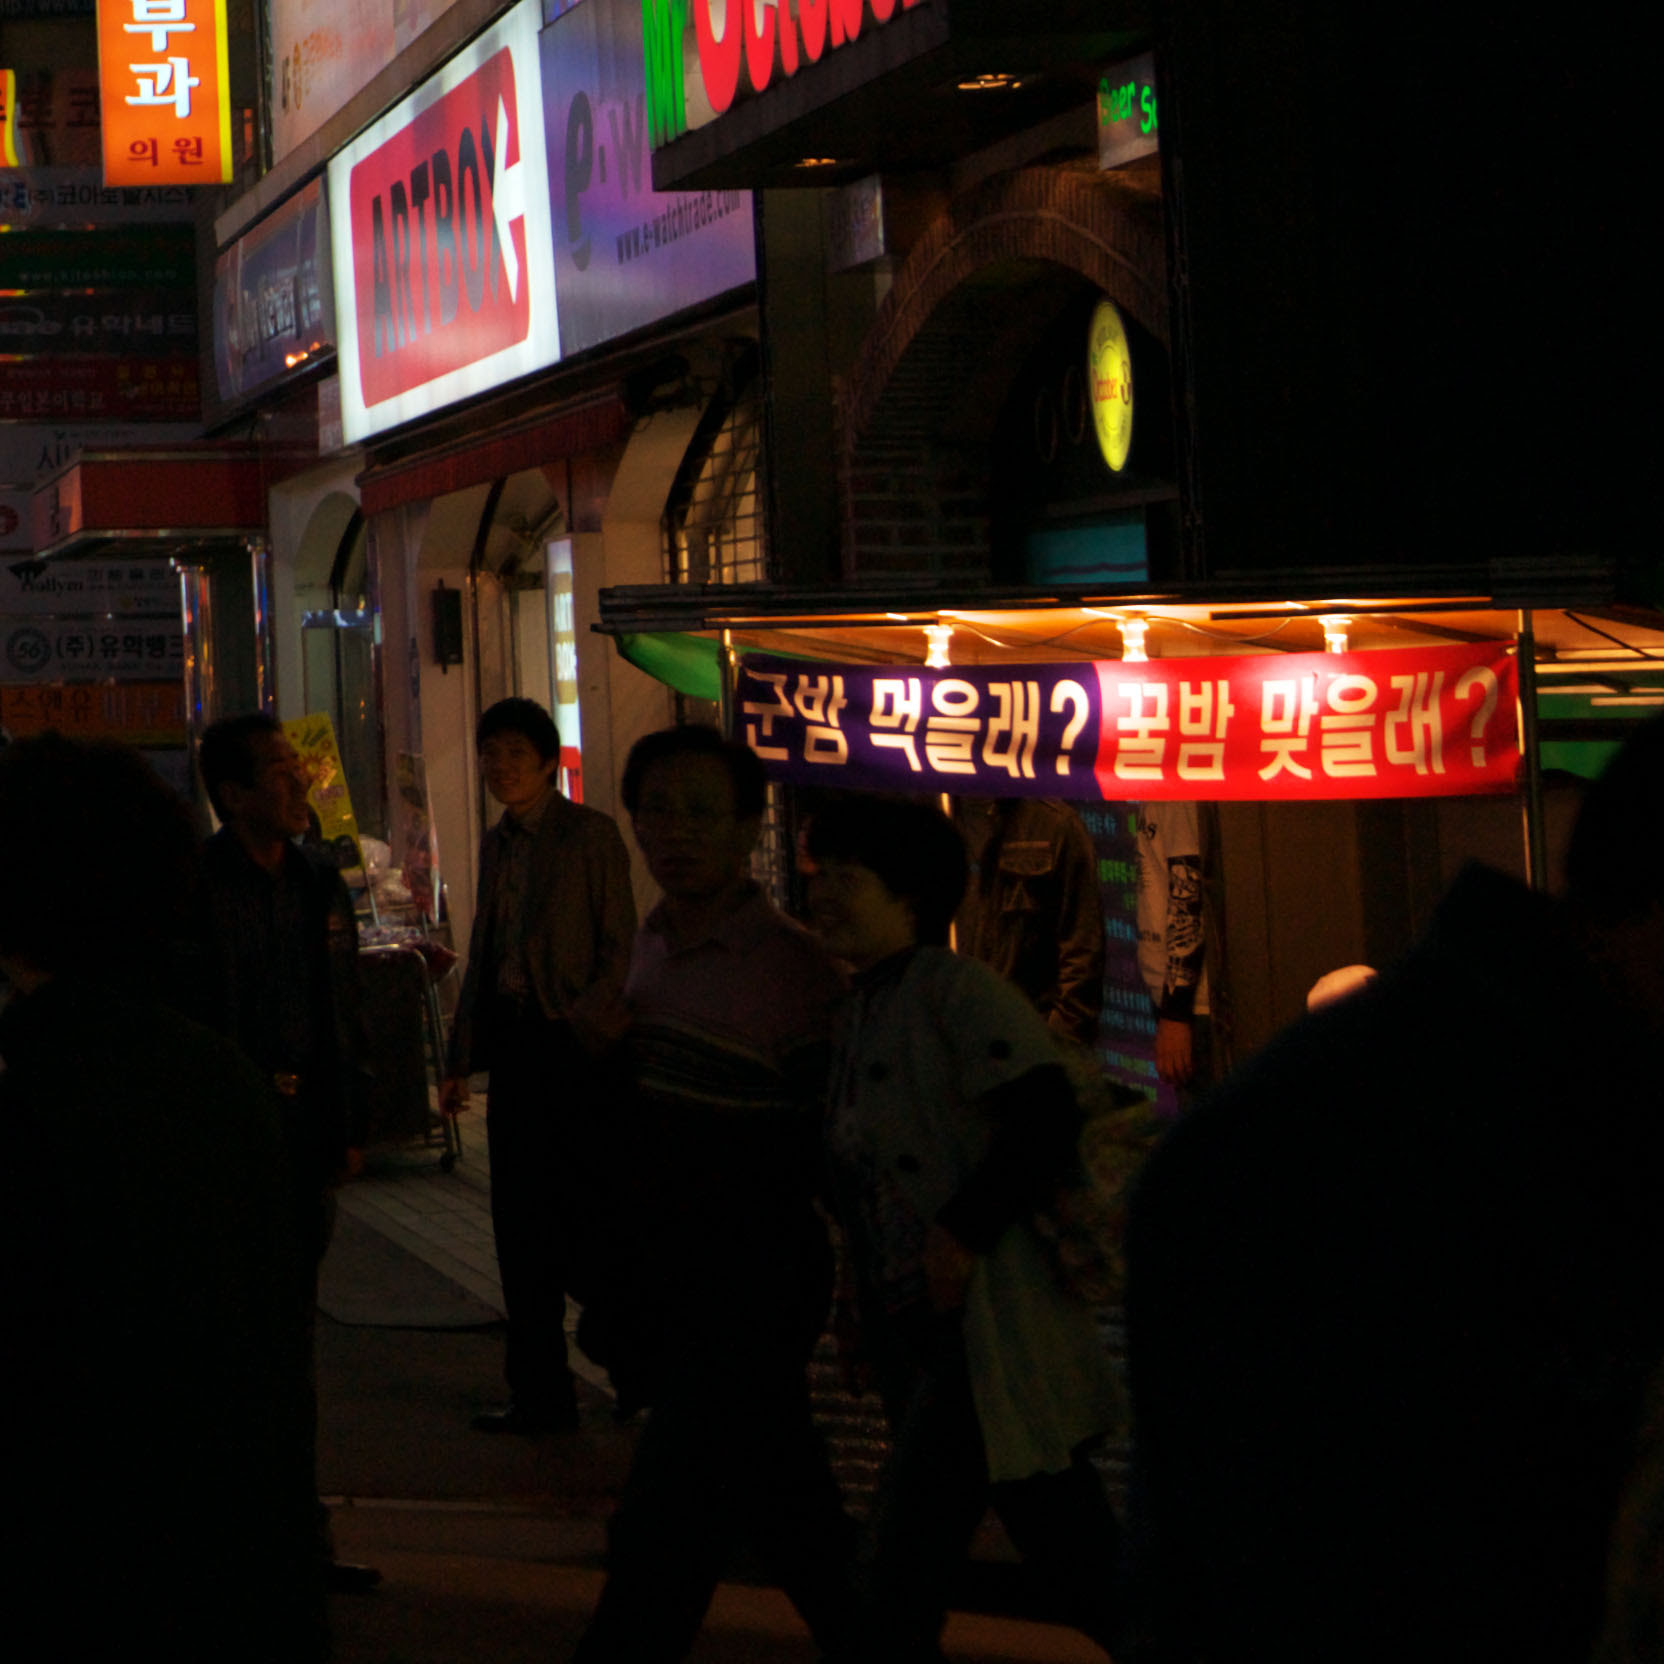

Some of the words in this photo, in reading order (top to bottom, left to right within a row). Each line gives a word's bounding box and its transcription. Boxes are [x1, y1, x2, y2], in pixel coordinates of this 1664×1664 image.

[127, 136, 204, 167] 의원
[369, 69, 525, 362] ARTBOX
[741, 673, 849, 767] 군밤
[868, 677, 1092, 780] 먹을래?
[1112, 680, 1234, 781] 꿀밤
[1259, 665, 1502, 784] 맞을래?
